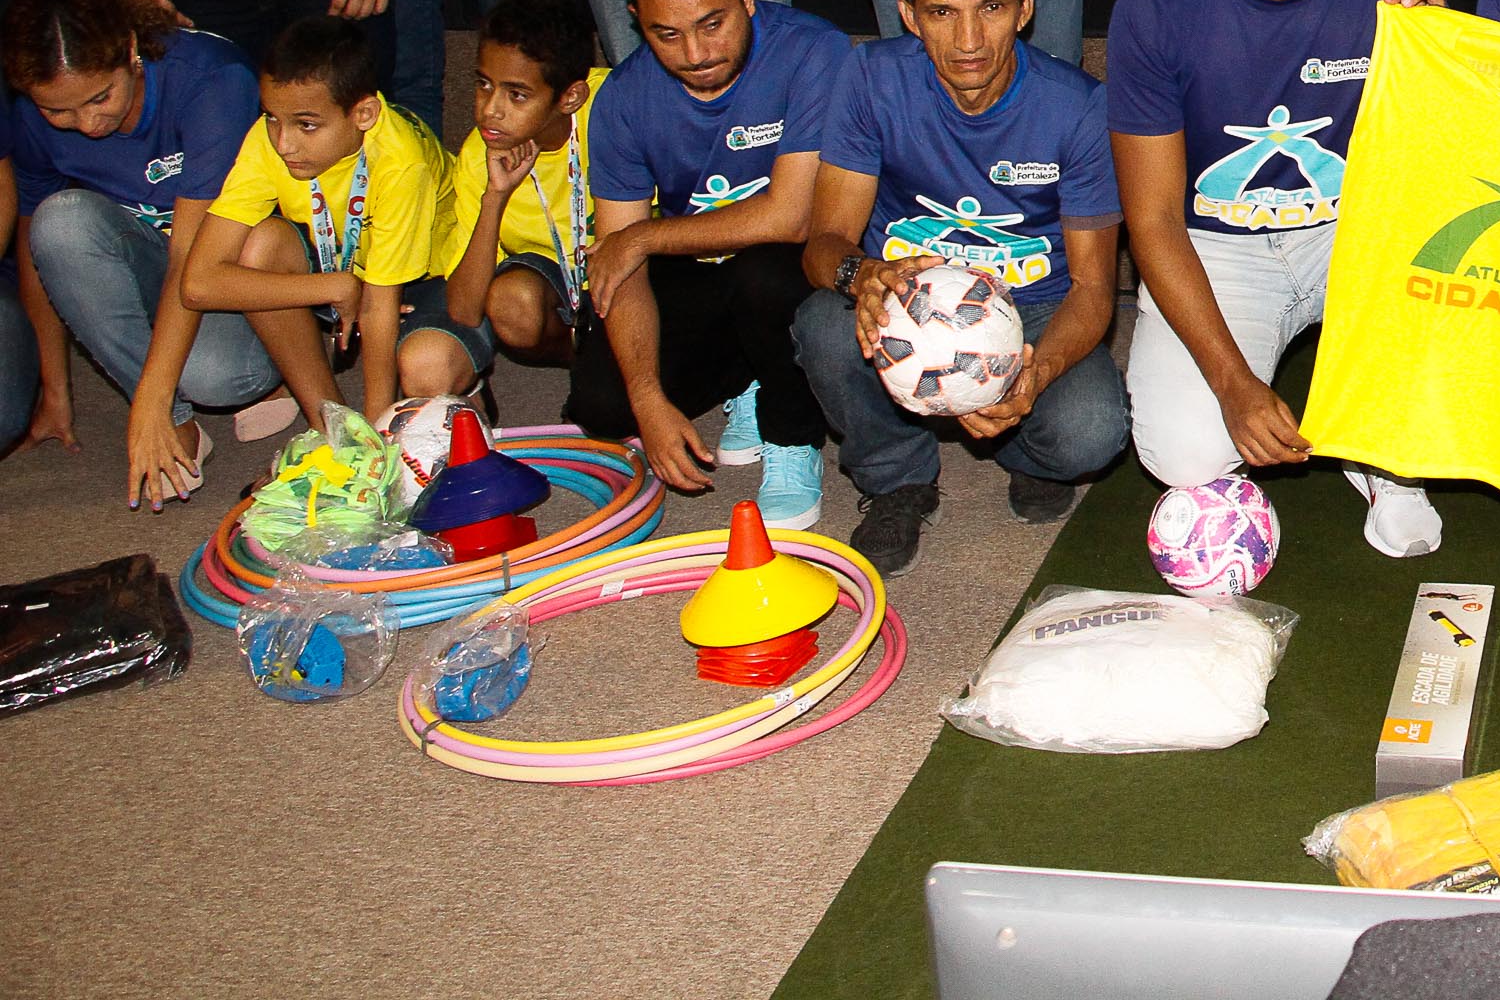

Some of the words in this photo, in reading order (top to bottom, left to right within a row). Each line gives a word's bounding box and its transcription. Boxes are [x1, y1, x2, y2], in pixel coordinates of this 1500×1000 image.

[1327, 60, 1359, 68] Prefeitura
[1327, 67, 1369, 77] Fortaleza
[750, 125, 779, 134] Prefeitura
[1017, 172, 1058, 180] Fortaleza
[1245, 190, 1315, 205] ATLETA
[930, 243, 1006, 262] ATLETA
[1422, 652, 1440, 665] DE
[1411, 666, 1438, 705] ESCADA
[1431, 655, 1458, 706] AGILIDADE
